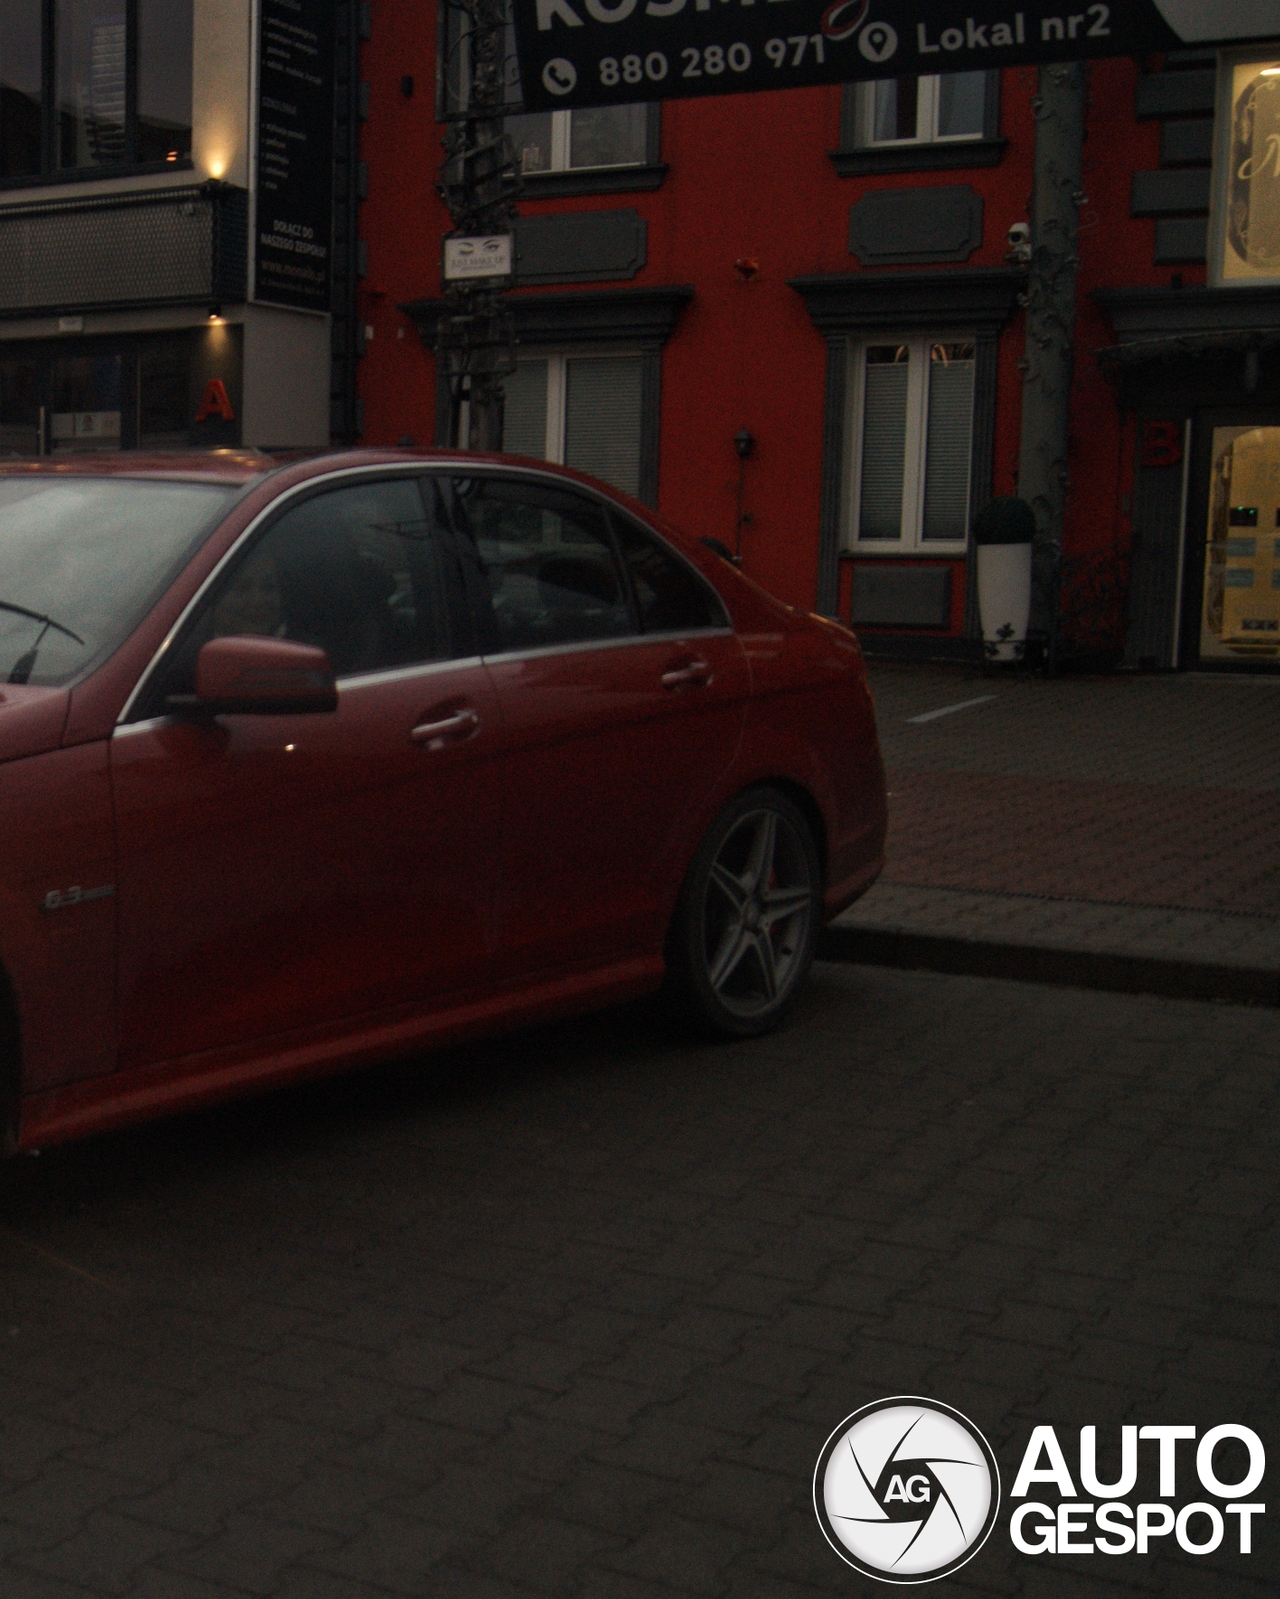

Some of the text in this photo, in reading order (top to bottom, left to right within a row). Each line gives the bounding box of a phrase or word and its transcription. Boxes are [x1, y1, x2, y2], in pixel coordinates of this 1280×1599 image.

[599, 3, 1111, 87] 880 280 971 Lokal nr2
[195, 379, 235, 422] A
[1140, 418, 1183, 466] B
